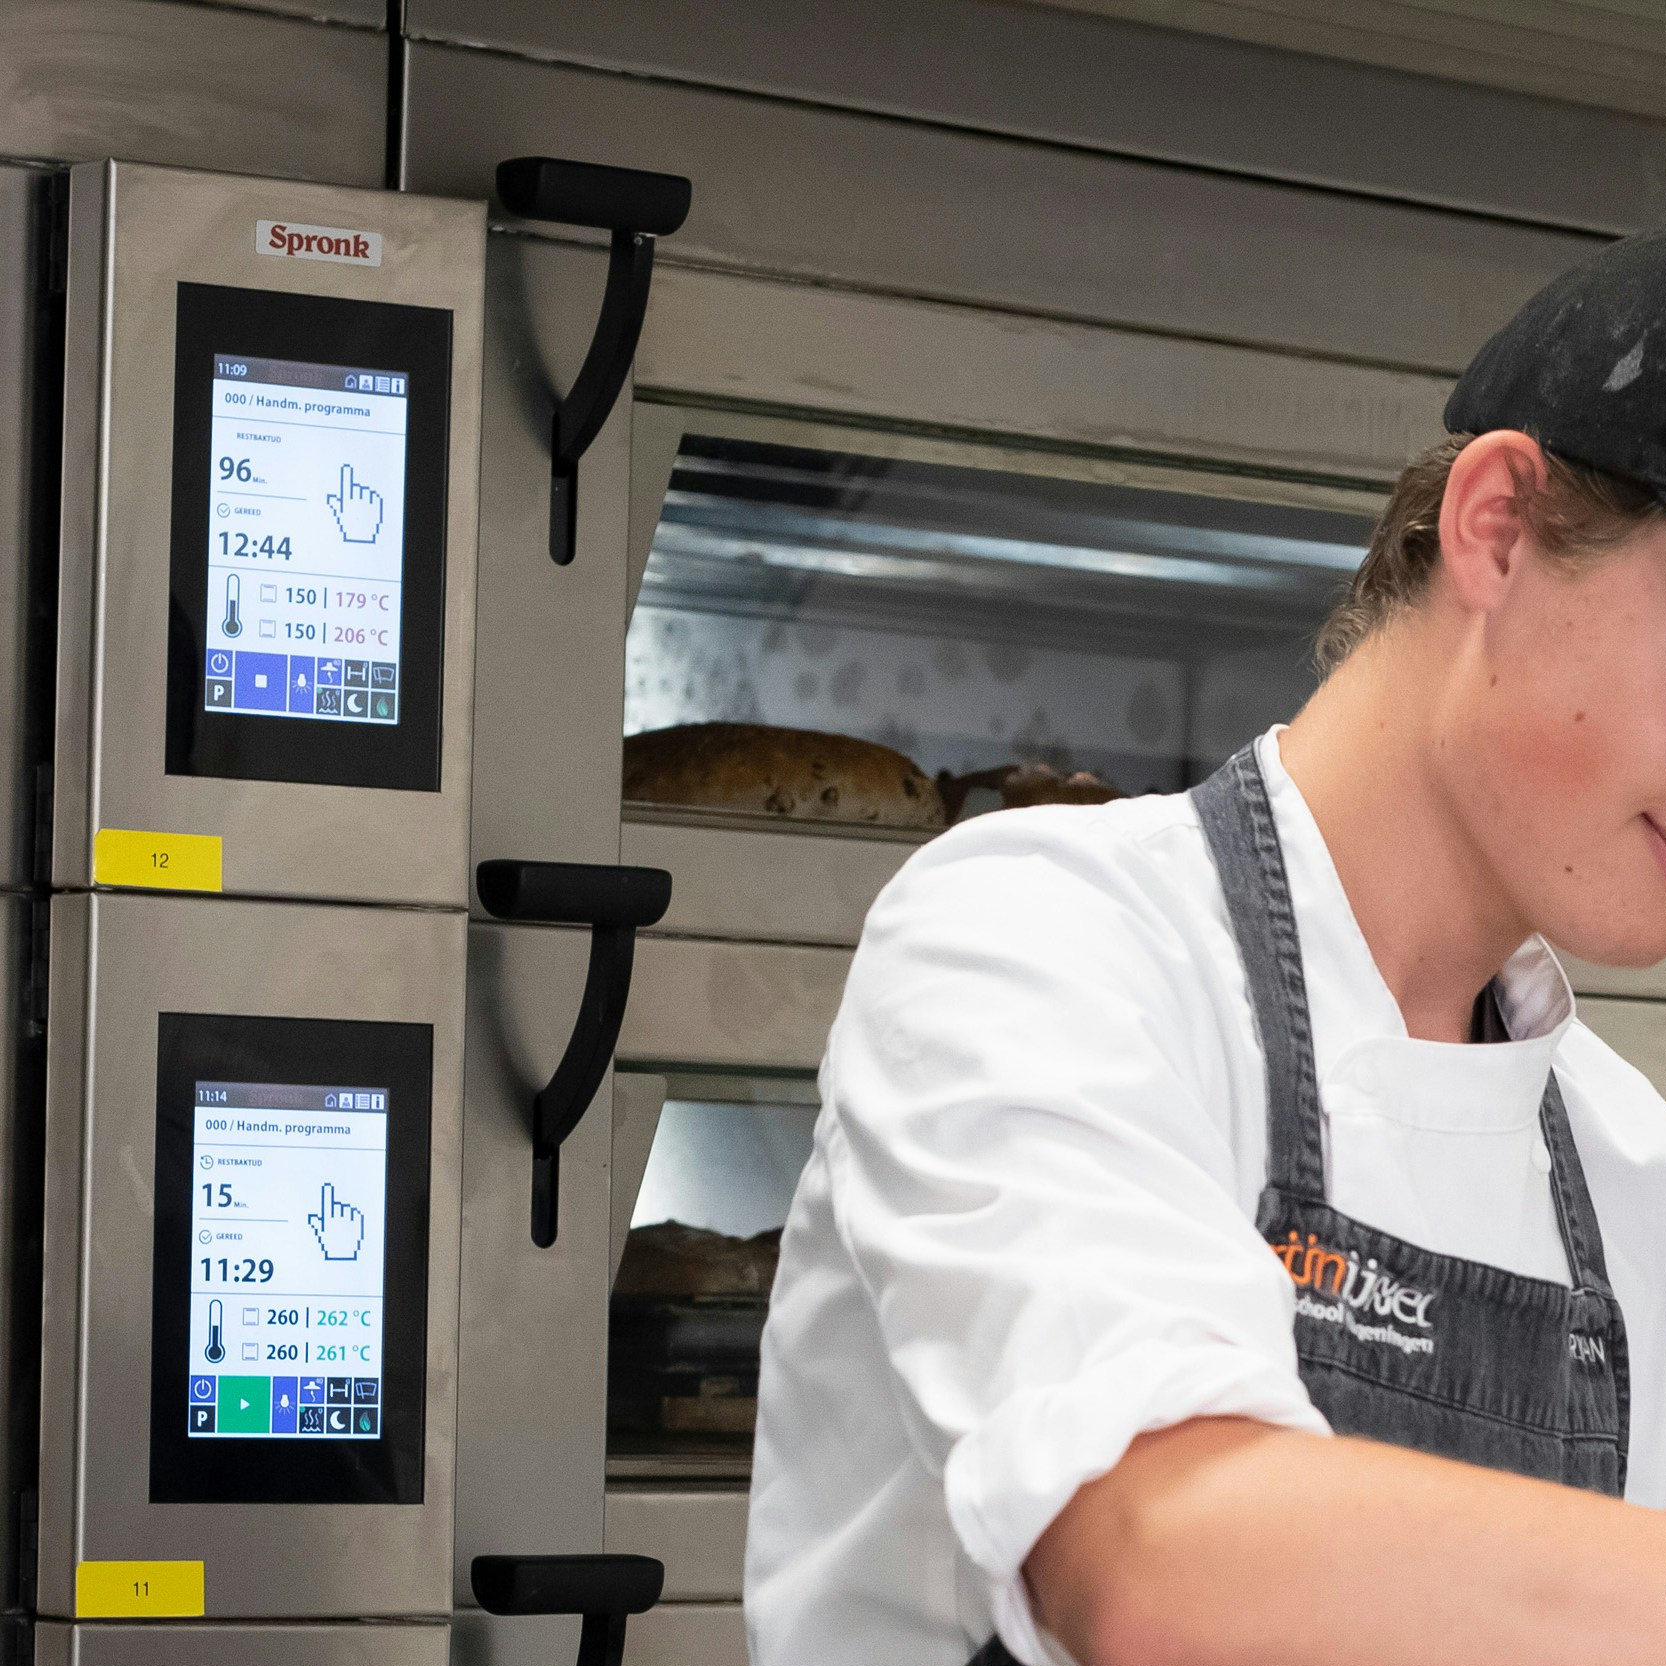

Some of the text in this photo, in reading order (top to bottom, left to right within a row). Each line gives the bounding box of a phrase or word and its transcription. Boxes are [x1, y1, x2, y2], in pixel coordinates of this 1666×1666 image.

[269, 224, 369, 258] Spronk
[218, 362, 247, 376] 11:09
[225, 393, 371, 417] 000 / Handm. programma
[219, 456, 267, 485] 96 Min.
[234, 507, 261, 516] GEREED
[218, 531, 292, 560] 12:44
[286, 587, 389, 611] 150 179 °C
[285, 622, 388, 646] 150 206 °C
[151, 852, 169, 868] 12
[199, 1090, 227, 1103] 11:14
[205, 1119, 351, 1136] 000 / Handm. programma
[202, 1183, 249, 1209] 15 Min.
[216, 1233, 243, 1241] GEREED
[200, 1257, 274, 1283] 11:29
[267, 1309, 371, 1327] 260 262 °C
[266, 1344, 370, 1361] 260 261 °C
[133, 1581, 149, 1597] 11
